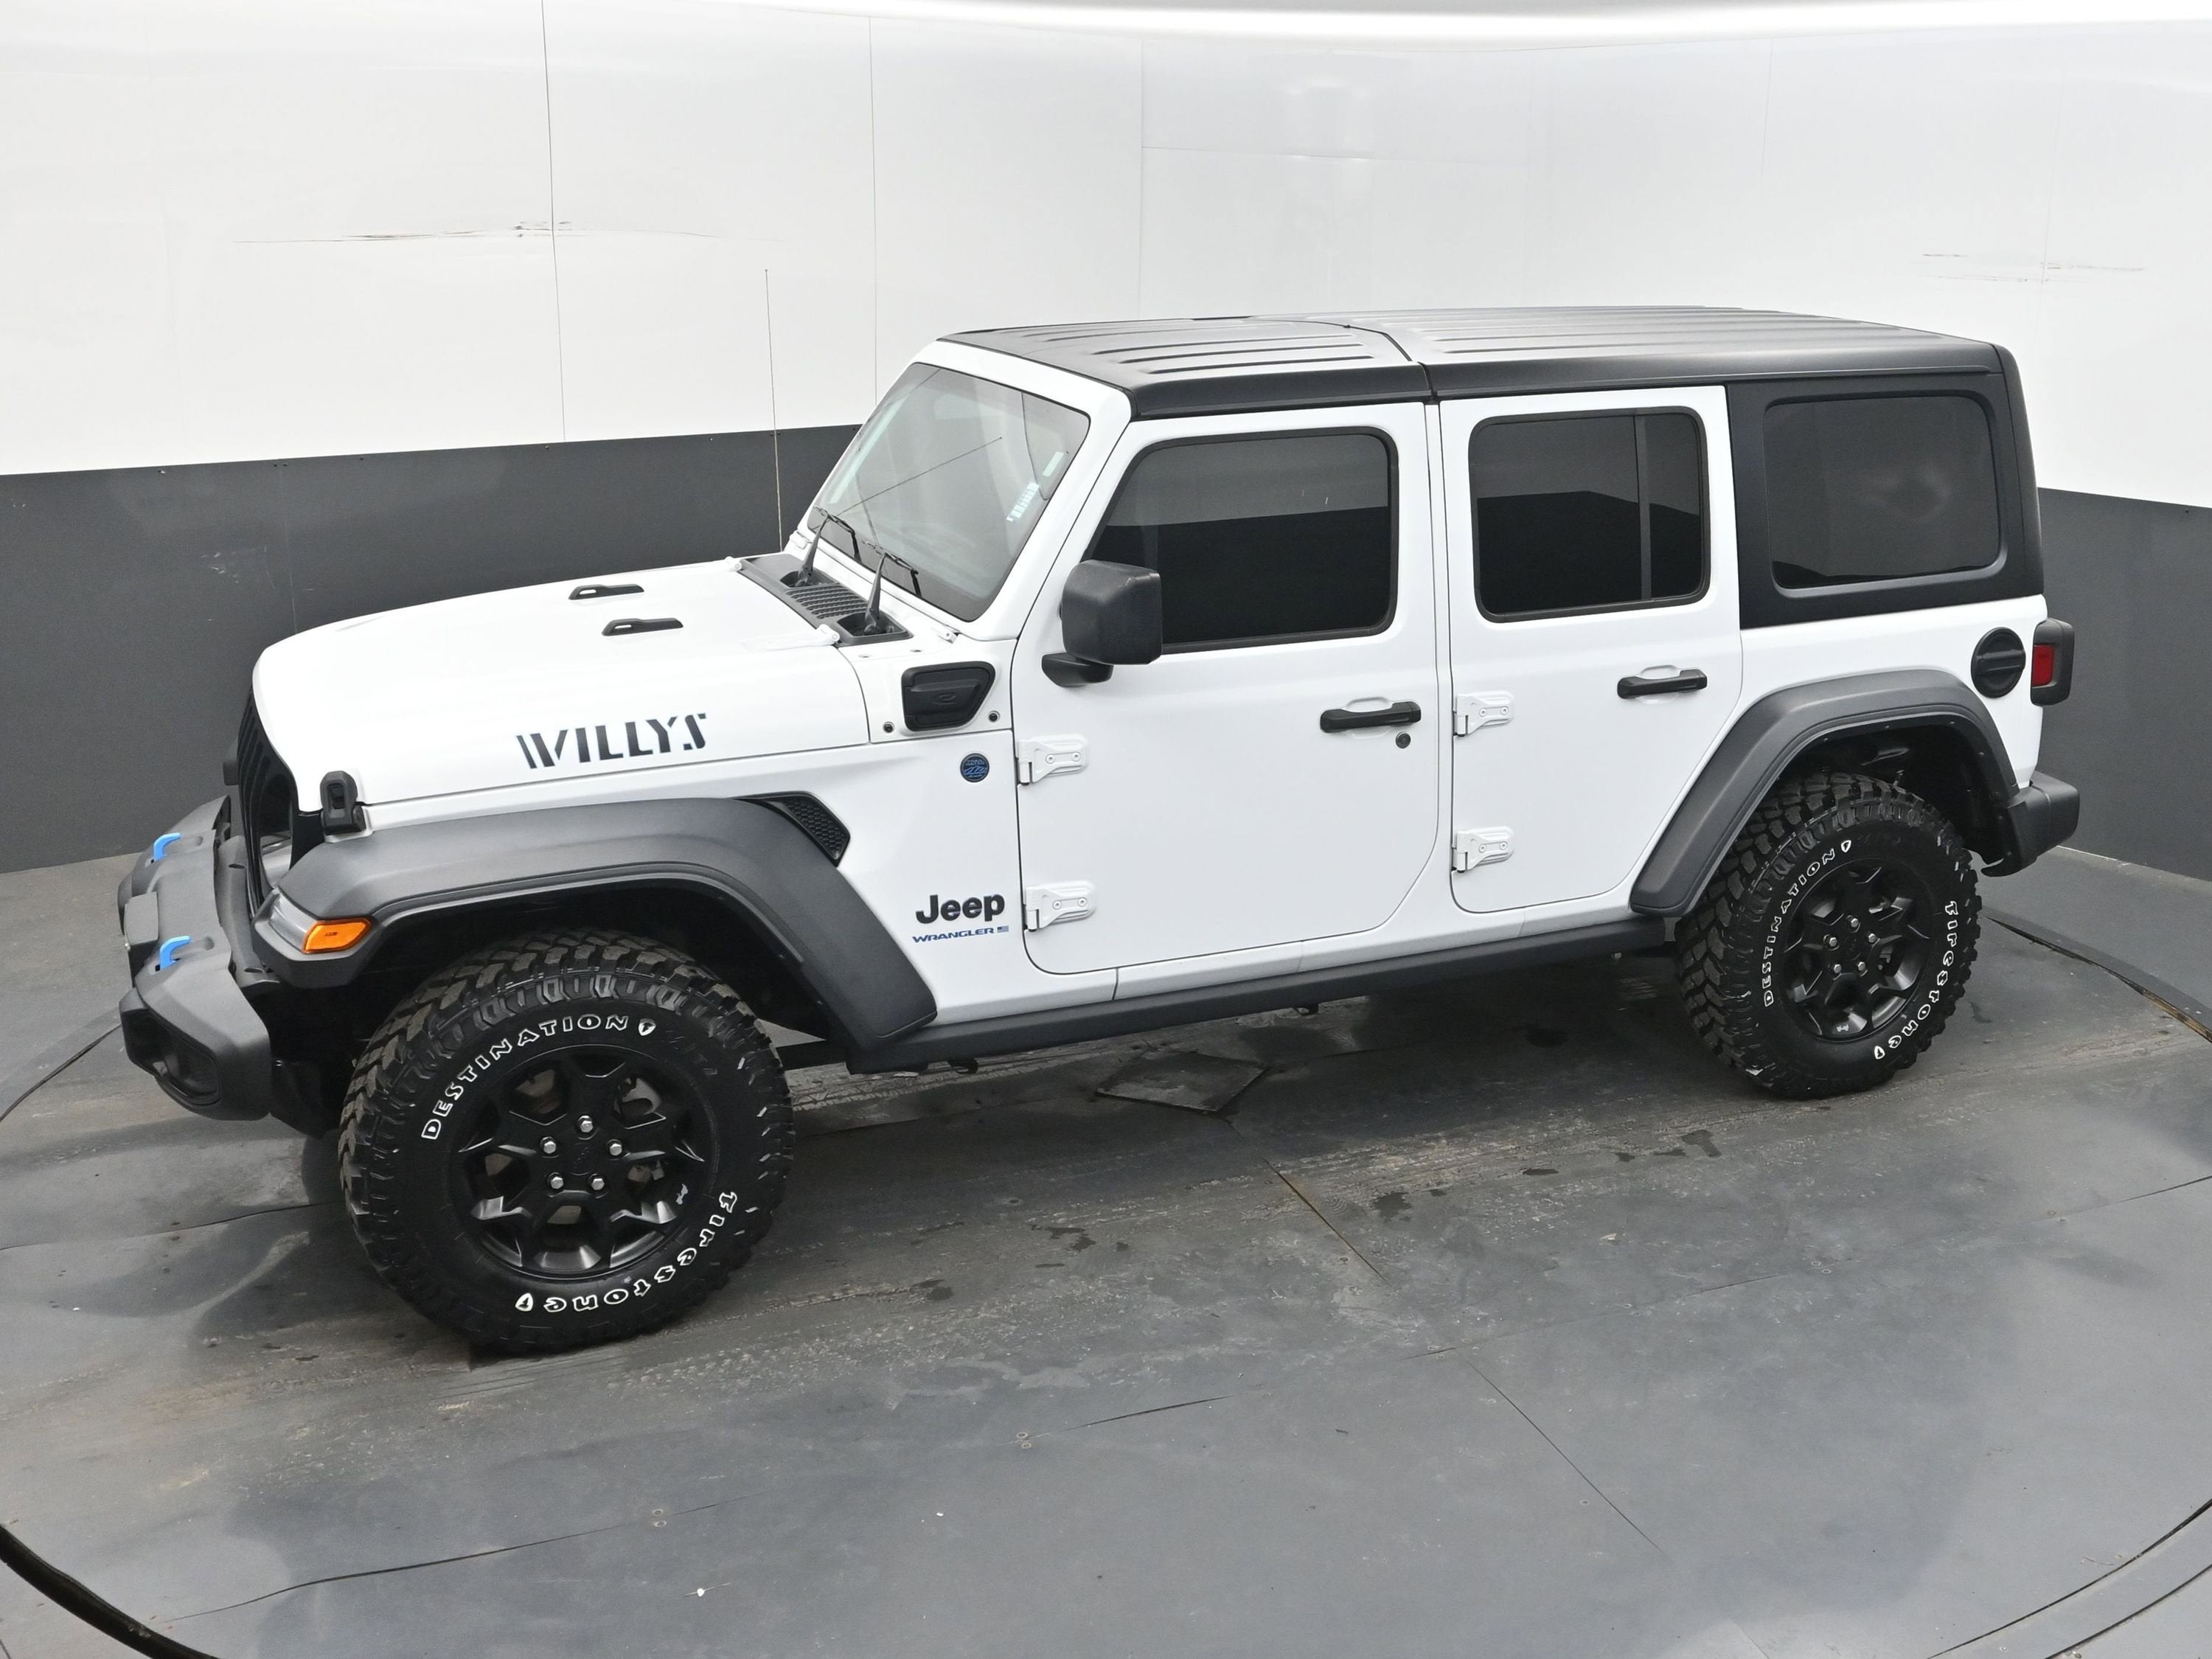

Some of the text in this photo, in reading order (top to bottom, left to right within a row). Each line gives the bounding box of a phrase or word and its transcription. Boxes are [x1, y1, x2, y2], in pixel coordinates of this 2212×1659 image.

[516, 712, 706, 769] WILLYS
[912, 927, 994, 943] WRANGLER
[916, 894, 1005, 924] Jeep
[1762, 849, 1835, 1007] DESTINATION
[421, 1014, 629, 1140] DESTINATION
